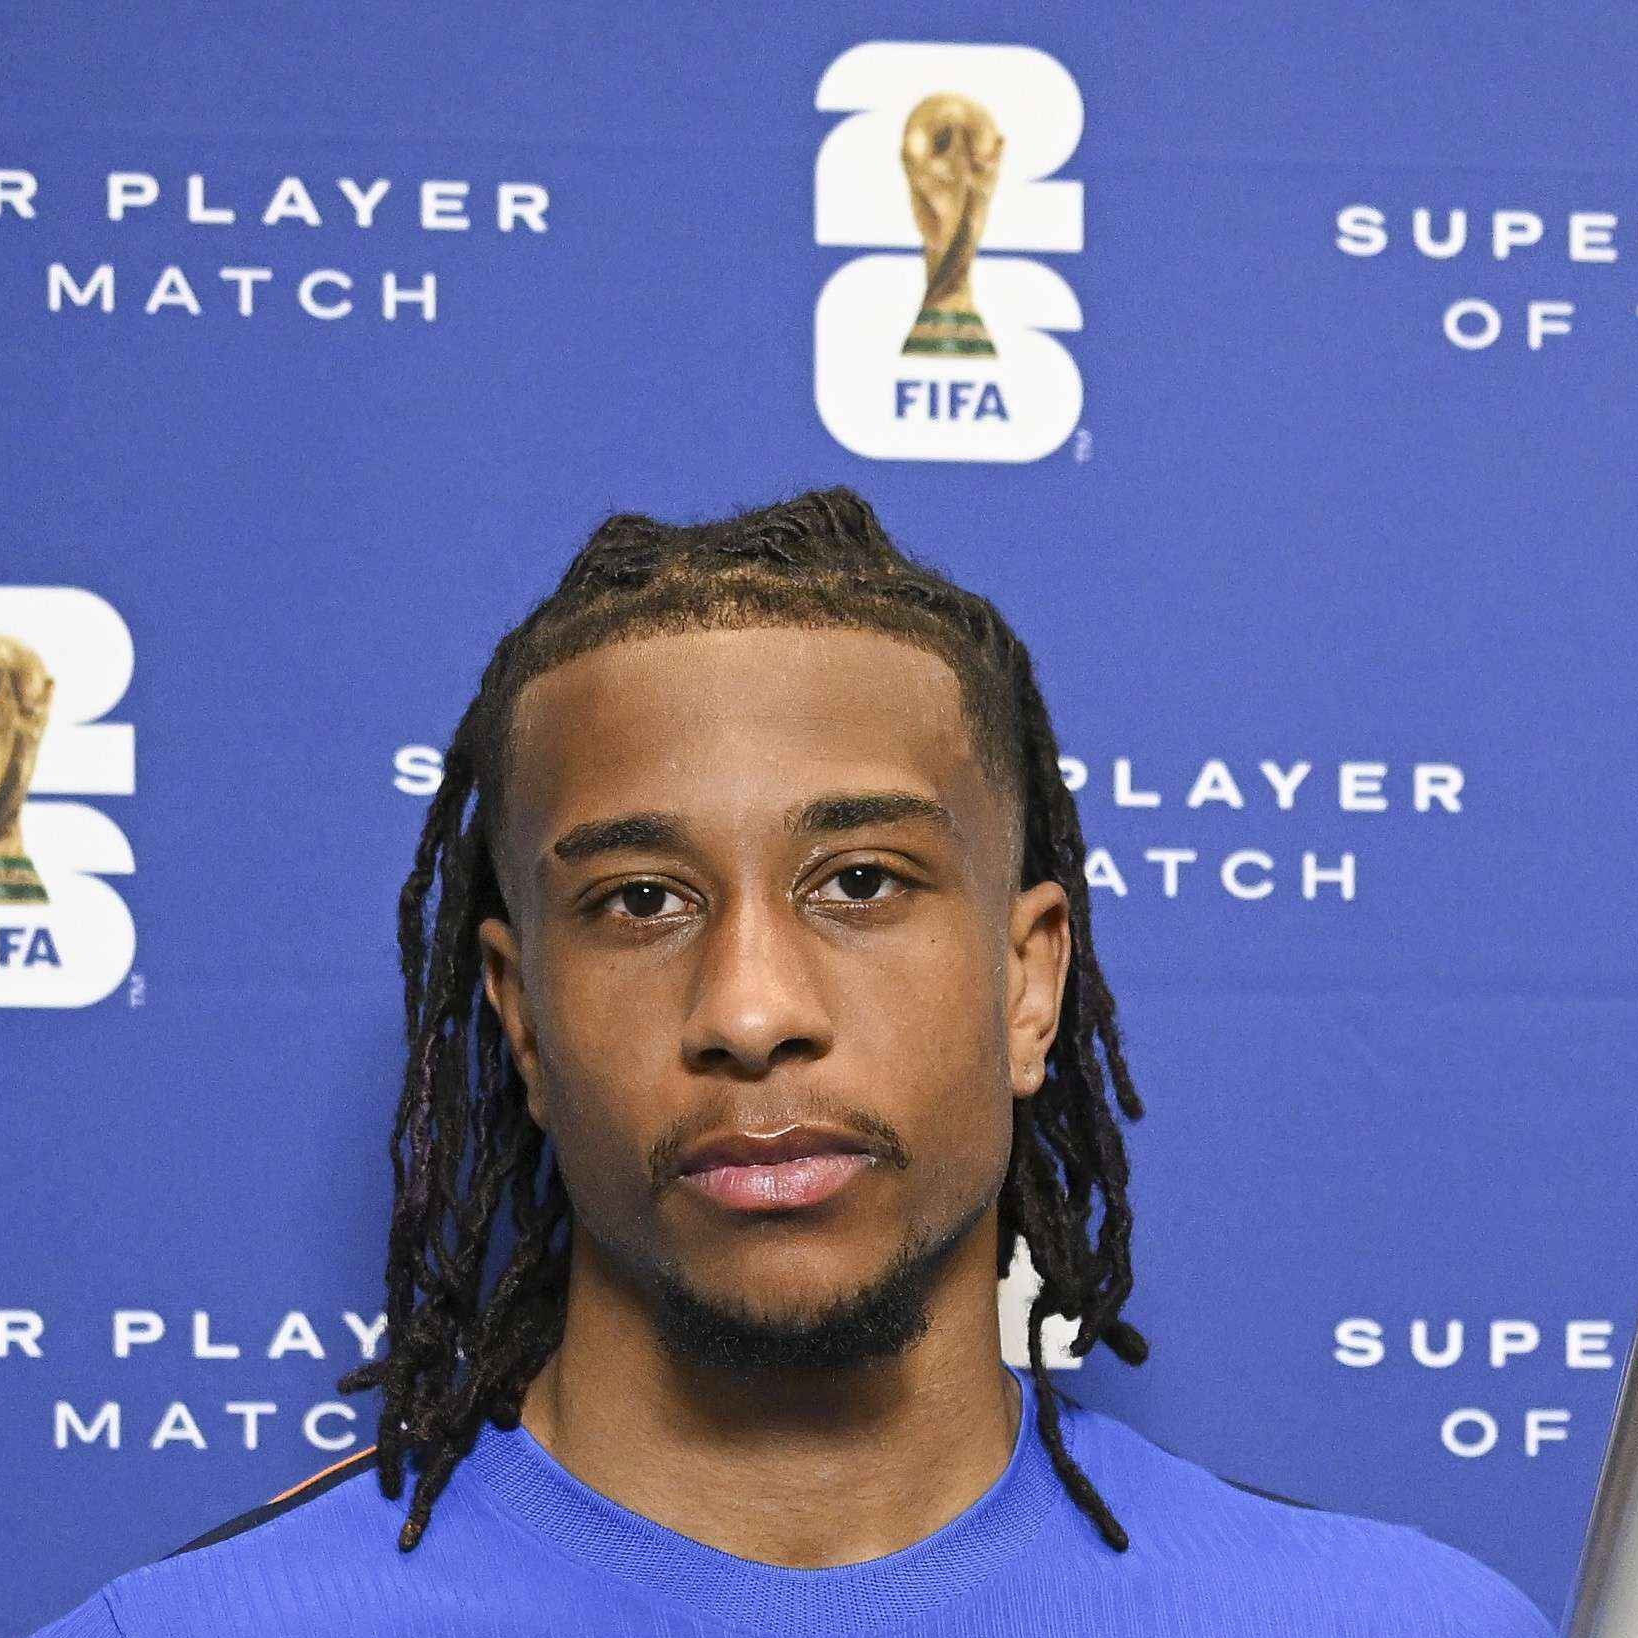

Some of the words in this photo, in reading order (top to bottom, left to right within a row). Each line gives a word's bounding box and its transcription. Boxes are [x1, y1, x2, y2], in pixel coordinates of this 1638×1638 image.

[106, 171, 550, 234] PLAYER
[47, 261, 437, 322] MATCH
[1443, 298, 1576, 351] OF
[892, 380, 1009, 421] FIFA
[1083, 847, 1356, 901] ATCH
[112, 1309, 389, 1361] PLAY
[1333, 1317, 1614, 1370] SUPE
[53, 1399, 357, 1451] MATC
[1440, 1408, 1571, 1458] OF
